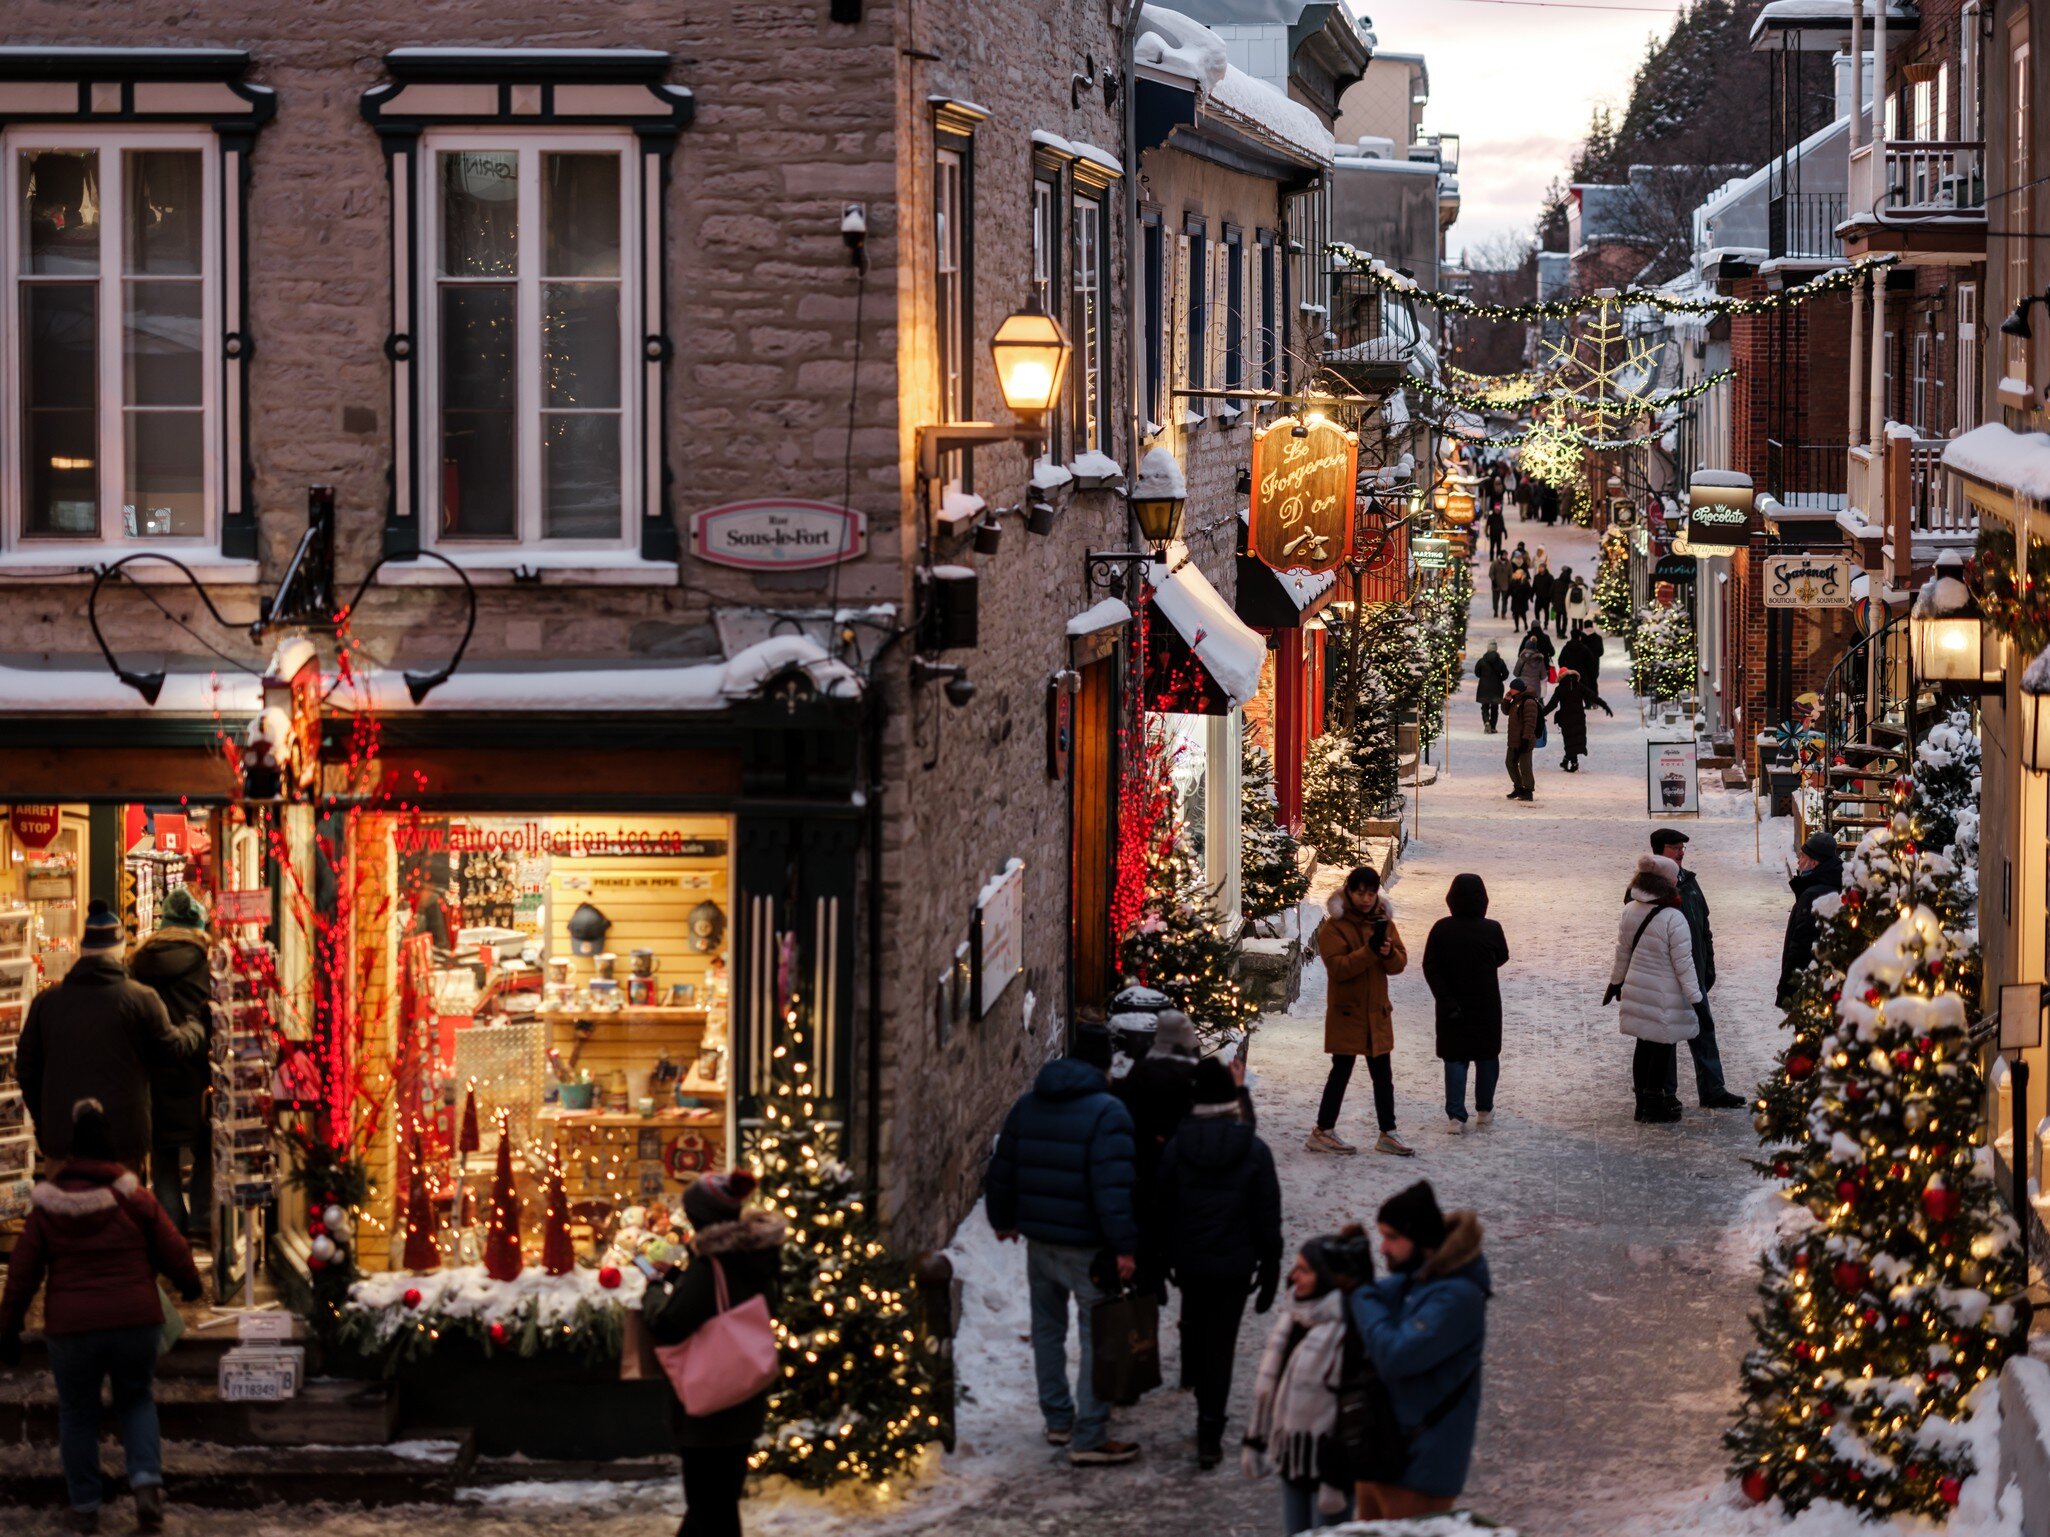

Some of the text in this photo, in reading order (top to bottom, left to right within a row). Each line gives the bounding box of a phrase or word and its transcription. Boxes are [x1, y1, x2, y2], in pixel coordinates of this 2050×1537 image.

[1283, 440, 1309, 464] Le
[1260, 452, 1347, 504] Forgeron
[769, 515, 788, 525] Rue
[1692, 505, 1748, 527] Chocolato
[727, 528, 829, 546] Sous-le-Fort
[20, 821, 51, 834] STOP
[593, 877, 631, 886] PRENEZ
[634, 877, 649, 886] UN
